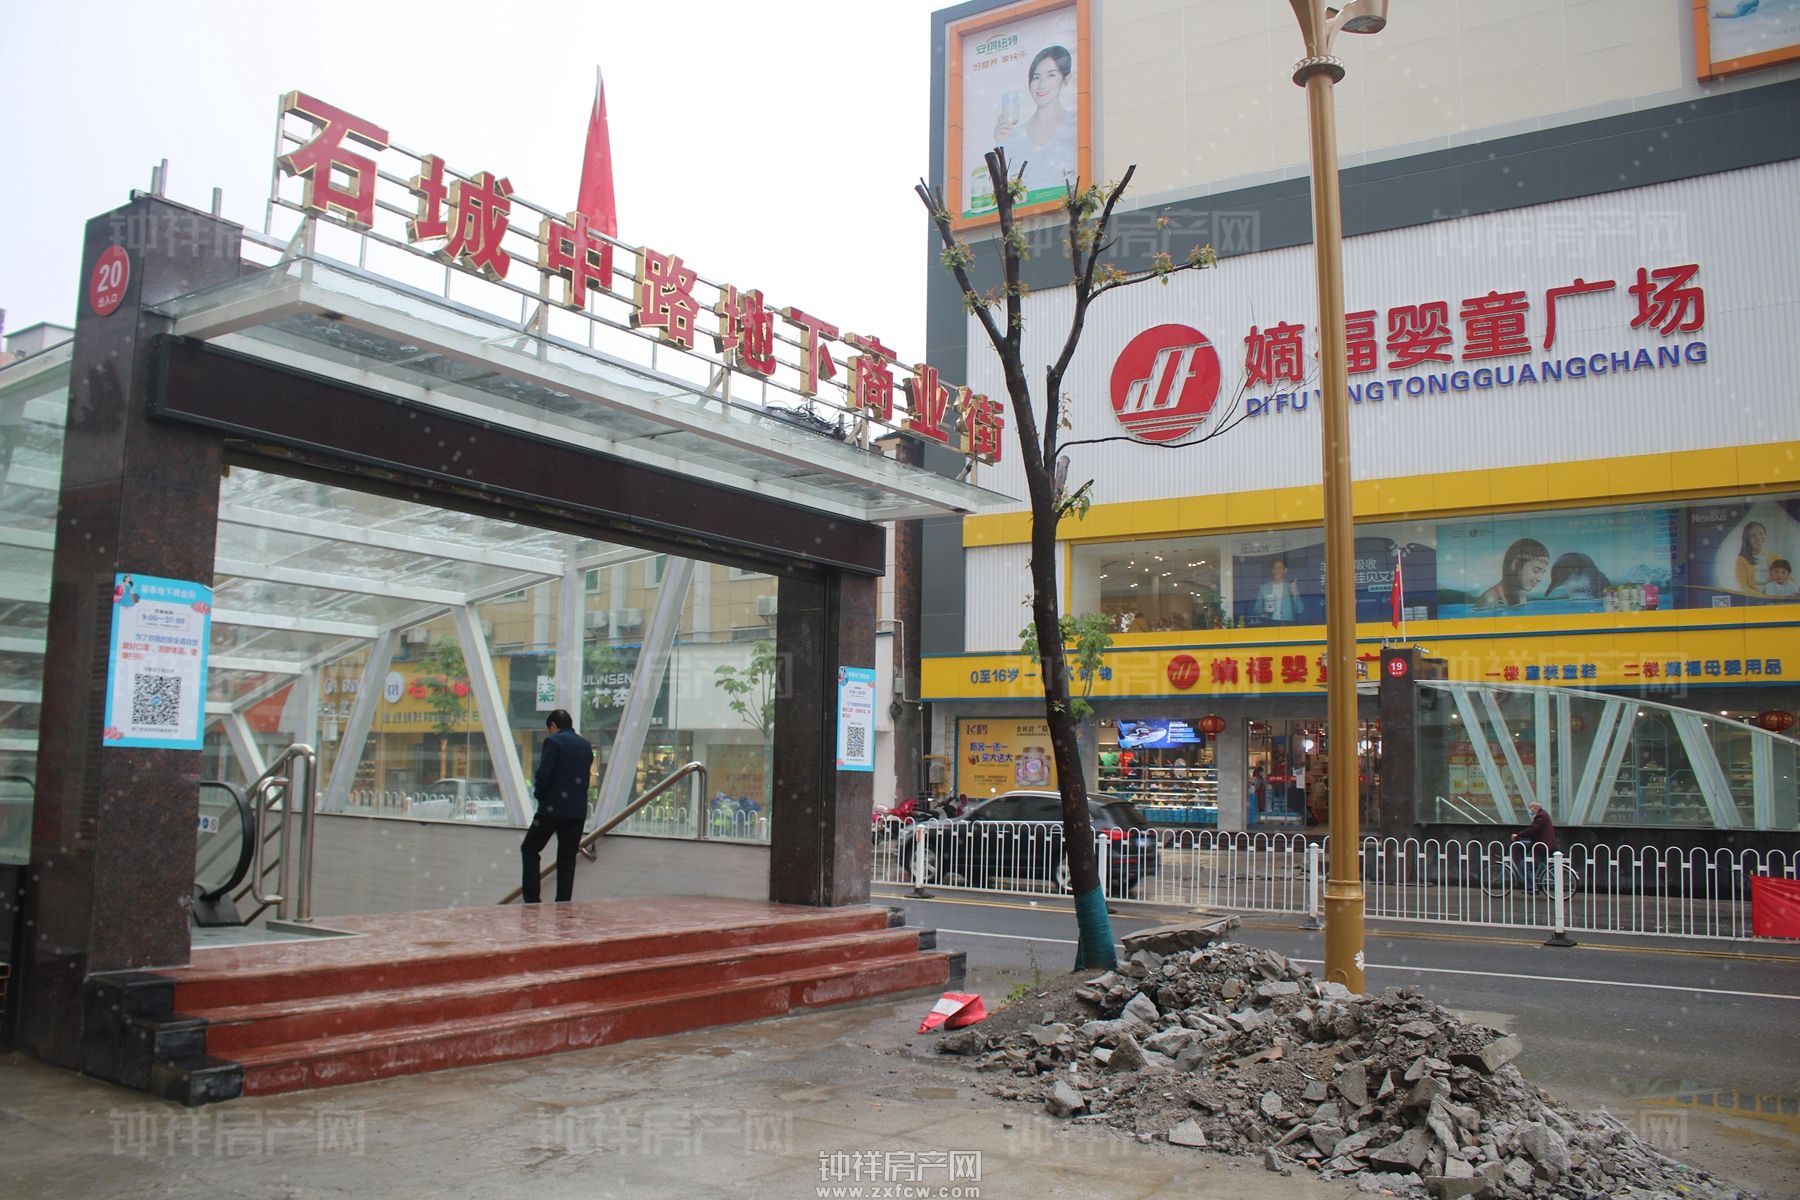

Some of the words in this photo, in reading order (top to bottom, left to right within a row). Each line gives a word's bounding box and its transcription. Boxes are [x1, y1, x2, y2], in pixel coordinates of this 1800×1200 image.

[97, 260, 122, 293] 20
[277, 89, 1005, 466] 石城中路地下商业街
[1390, 662, 1403, 671] 19
